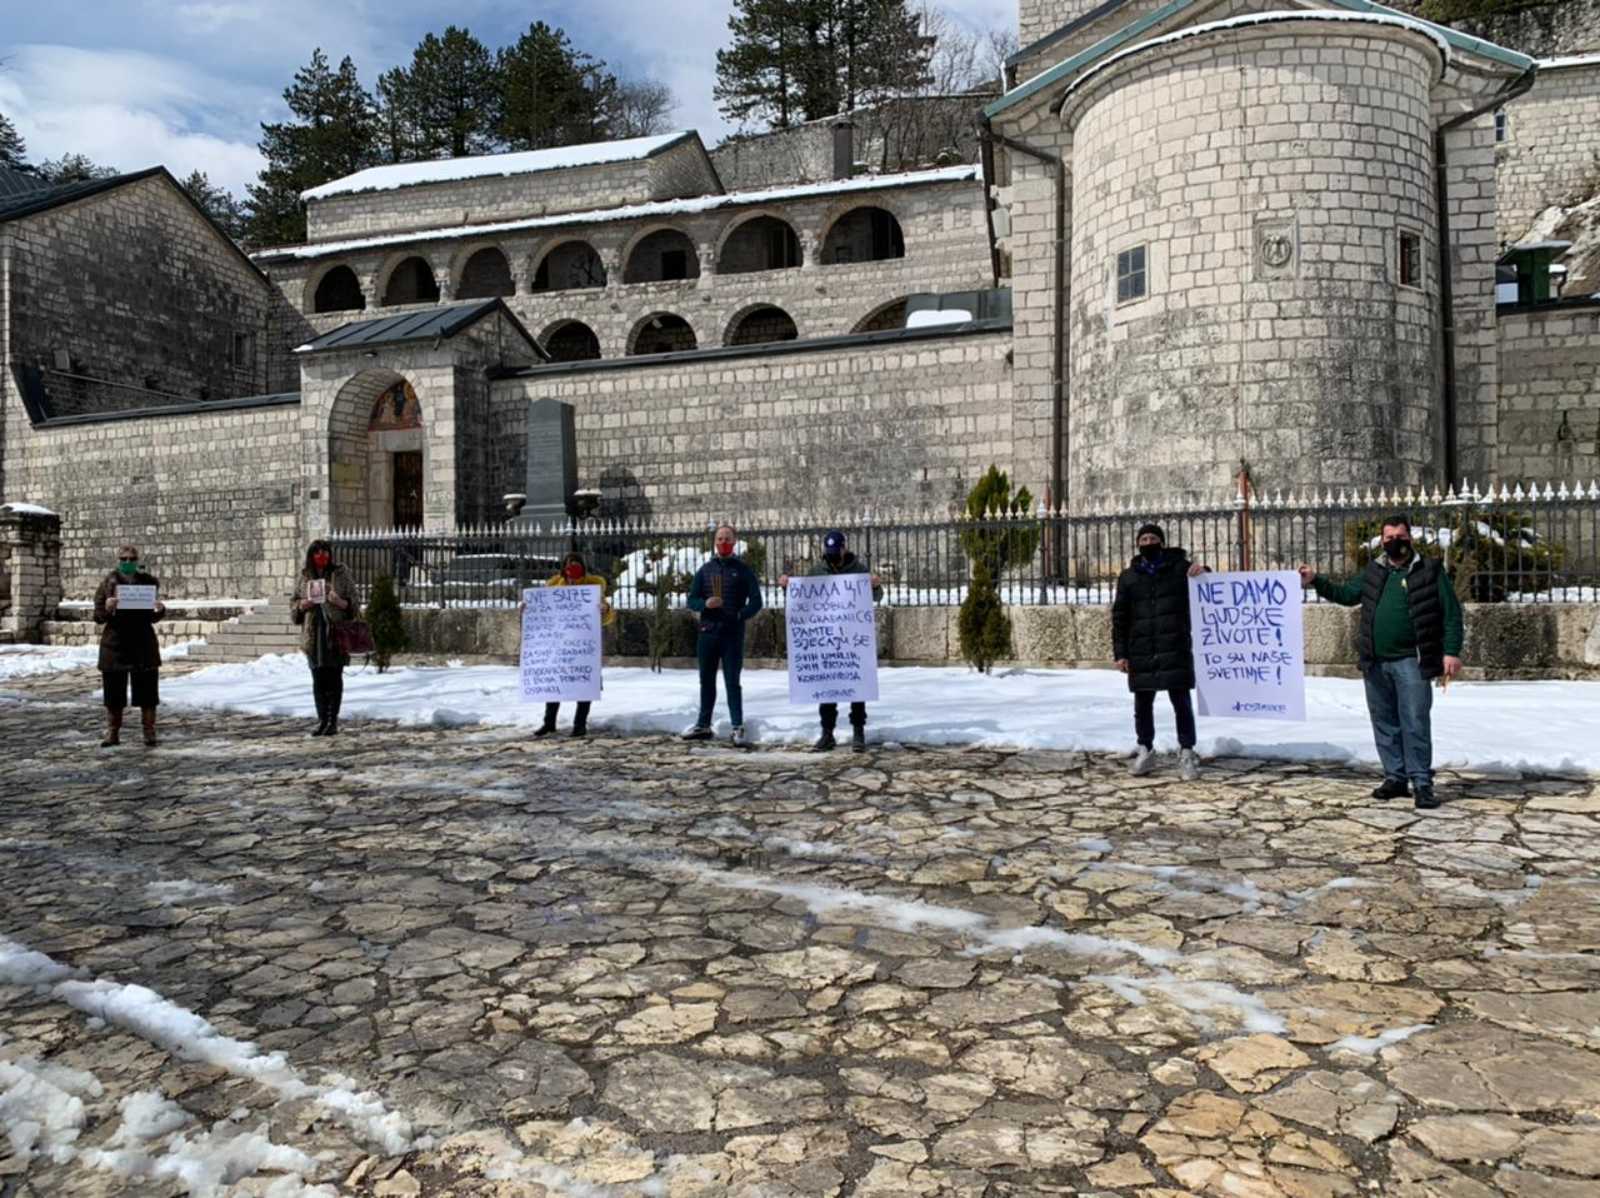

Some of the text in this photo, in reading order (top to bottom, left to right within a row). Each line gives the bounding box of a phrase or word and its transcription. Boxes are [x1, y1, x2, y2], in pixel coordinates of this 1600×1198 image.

[1197, 577, 1287, 606] NE DAMO
[791, 625, 834, 638] PAMTE
[1200, 652, 1222, 666] TO
